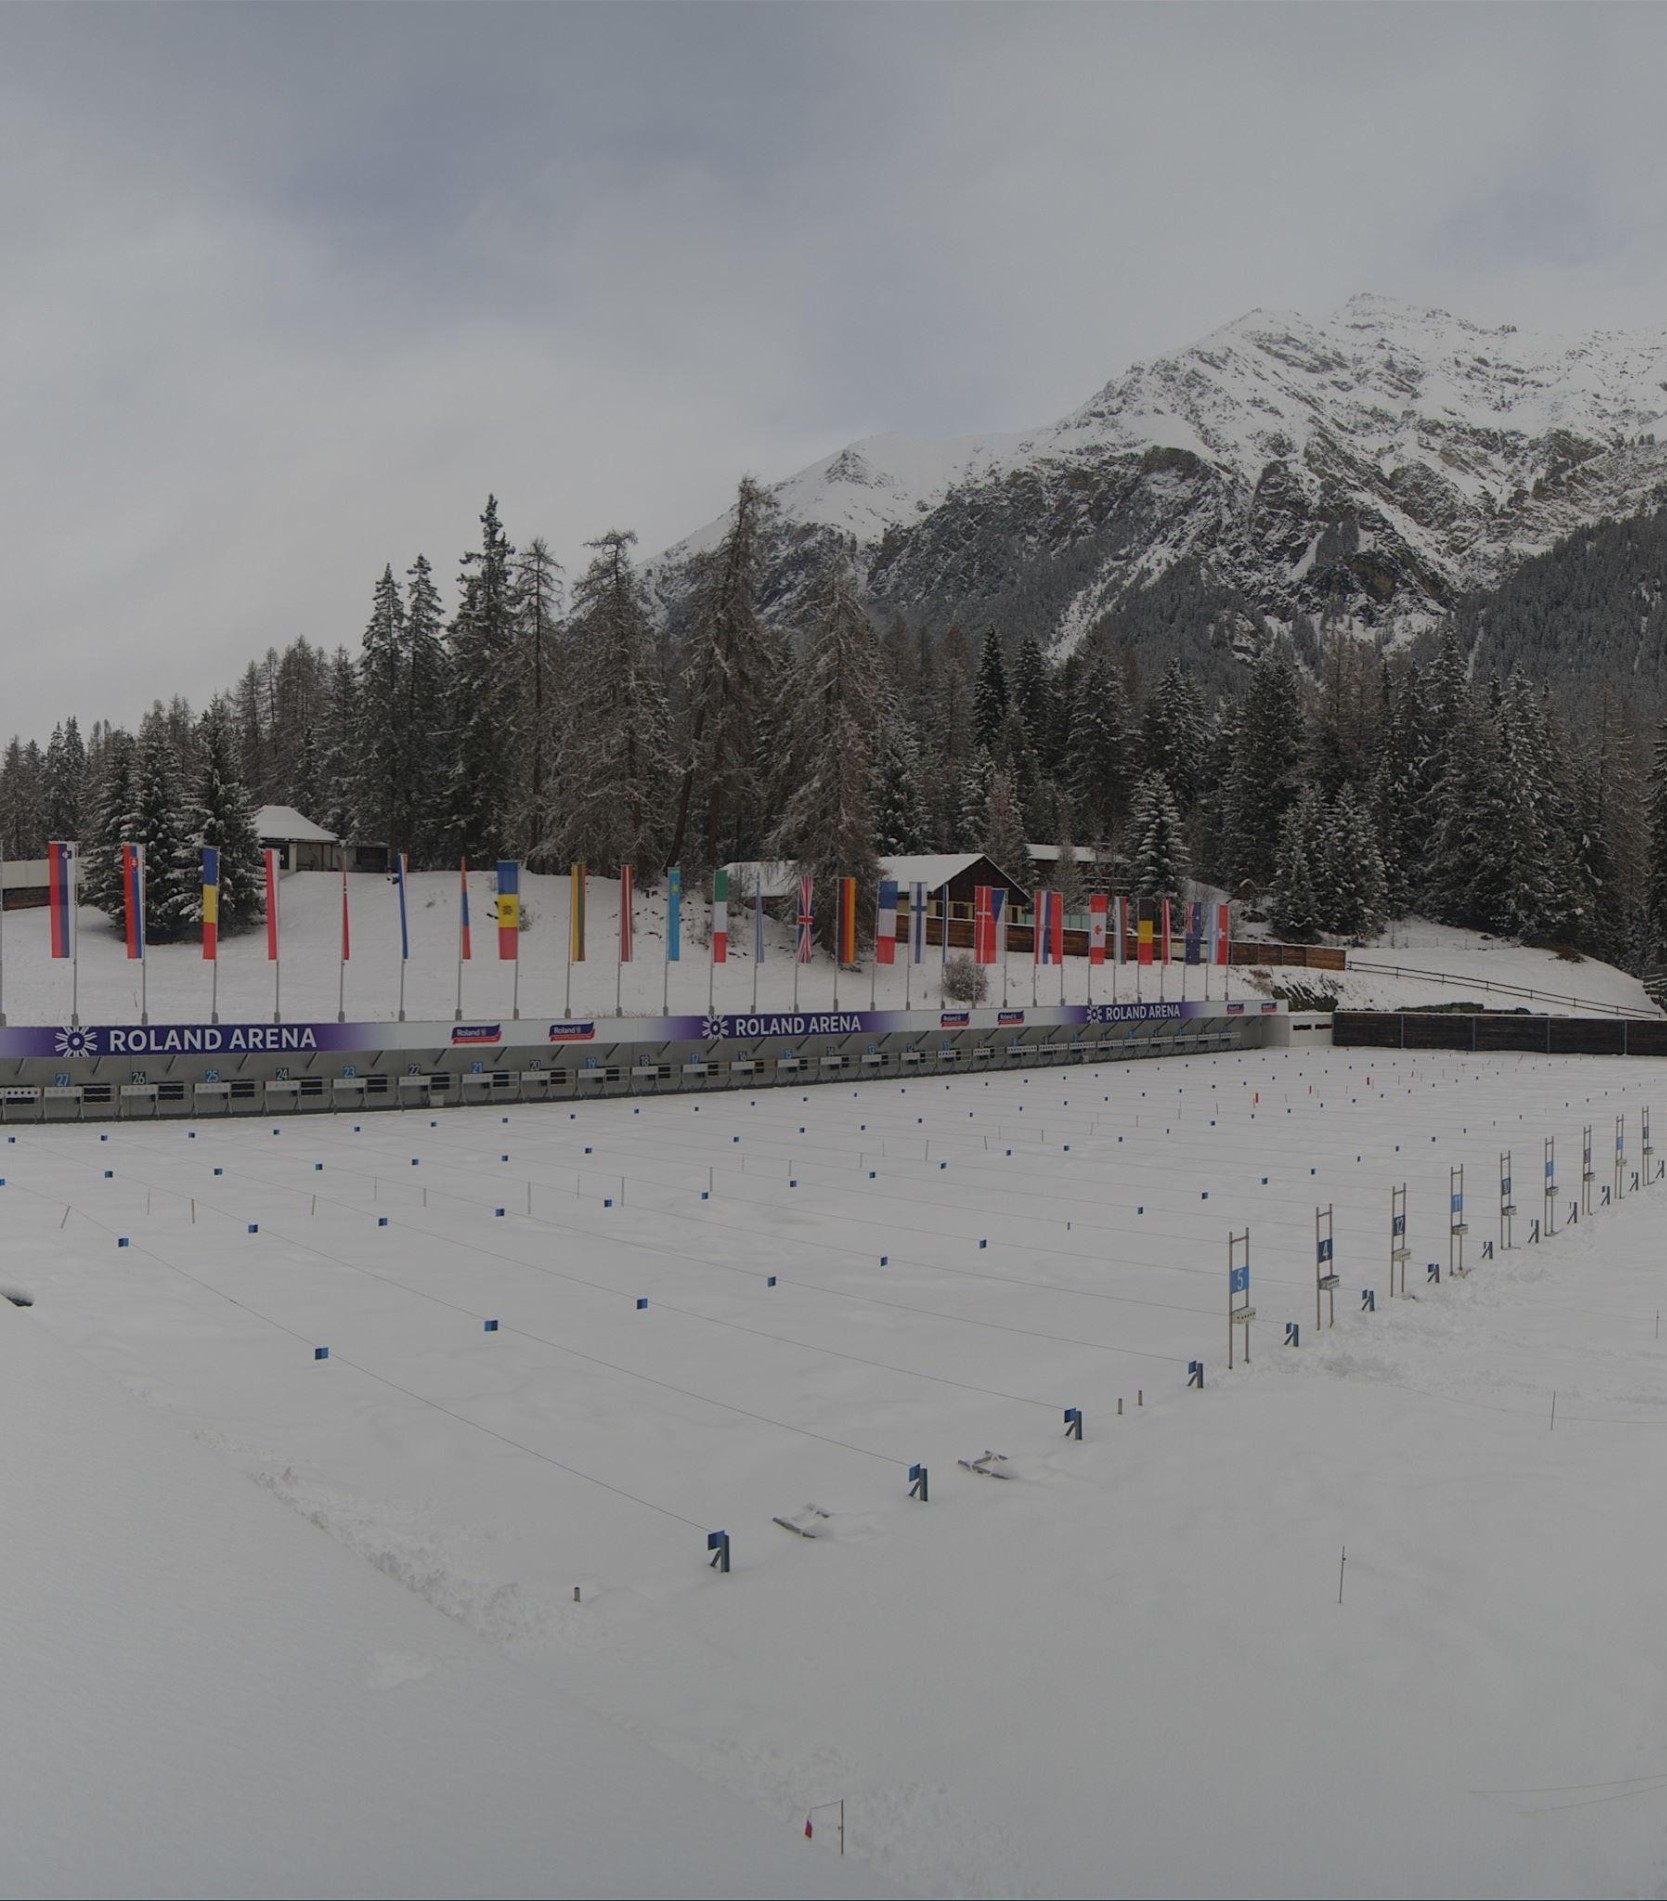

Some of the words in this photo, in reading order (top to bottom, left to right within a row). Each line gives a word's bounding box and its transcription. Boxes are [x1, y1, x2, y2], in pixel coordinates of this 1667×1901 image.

[1105, 1005, 1147, 1022] ROLAND
[1148, 1004, 1181, 1019] ARENA
[554, 1026, 576, 1034] Roland
[735, 1017, 805, 1037] ROLAND
[808, 1015, 862, 1034] ARENA
[109, 1028, 222, 1052] ROLAND
[229, 1028, 317, 1050] ARENA
[471, 1062, 483, 1073] 21
[530, 1060, 541, 1071] 20
[586, 1058, 597, 1069] 19
[205, 1070, 219, 1082] 25
[275, 1068, 289, 1081] 24
[343, 1066, 356, 1078] 23
[408, 1064, 421, 1076] 22
[56, 1074, 70, 1086] 27
[132, 1072, 145, 1085] 26
[1321, 1240, 1330, 1261] 4
[1236, 1271, 1244, 1291] 5
